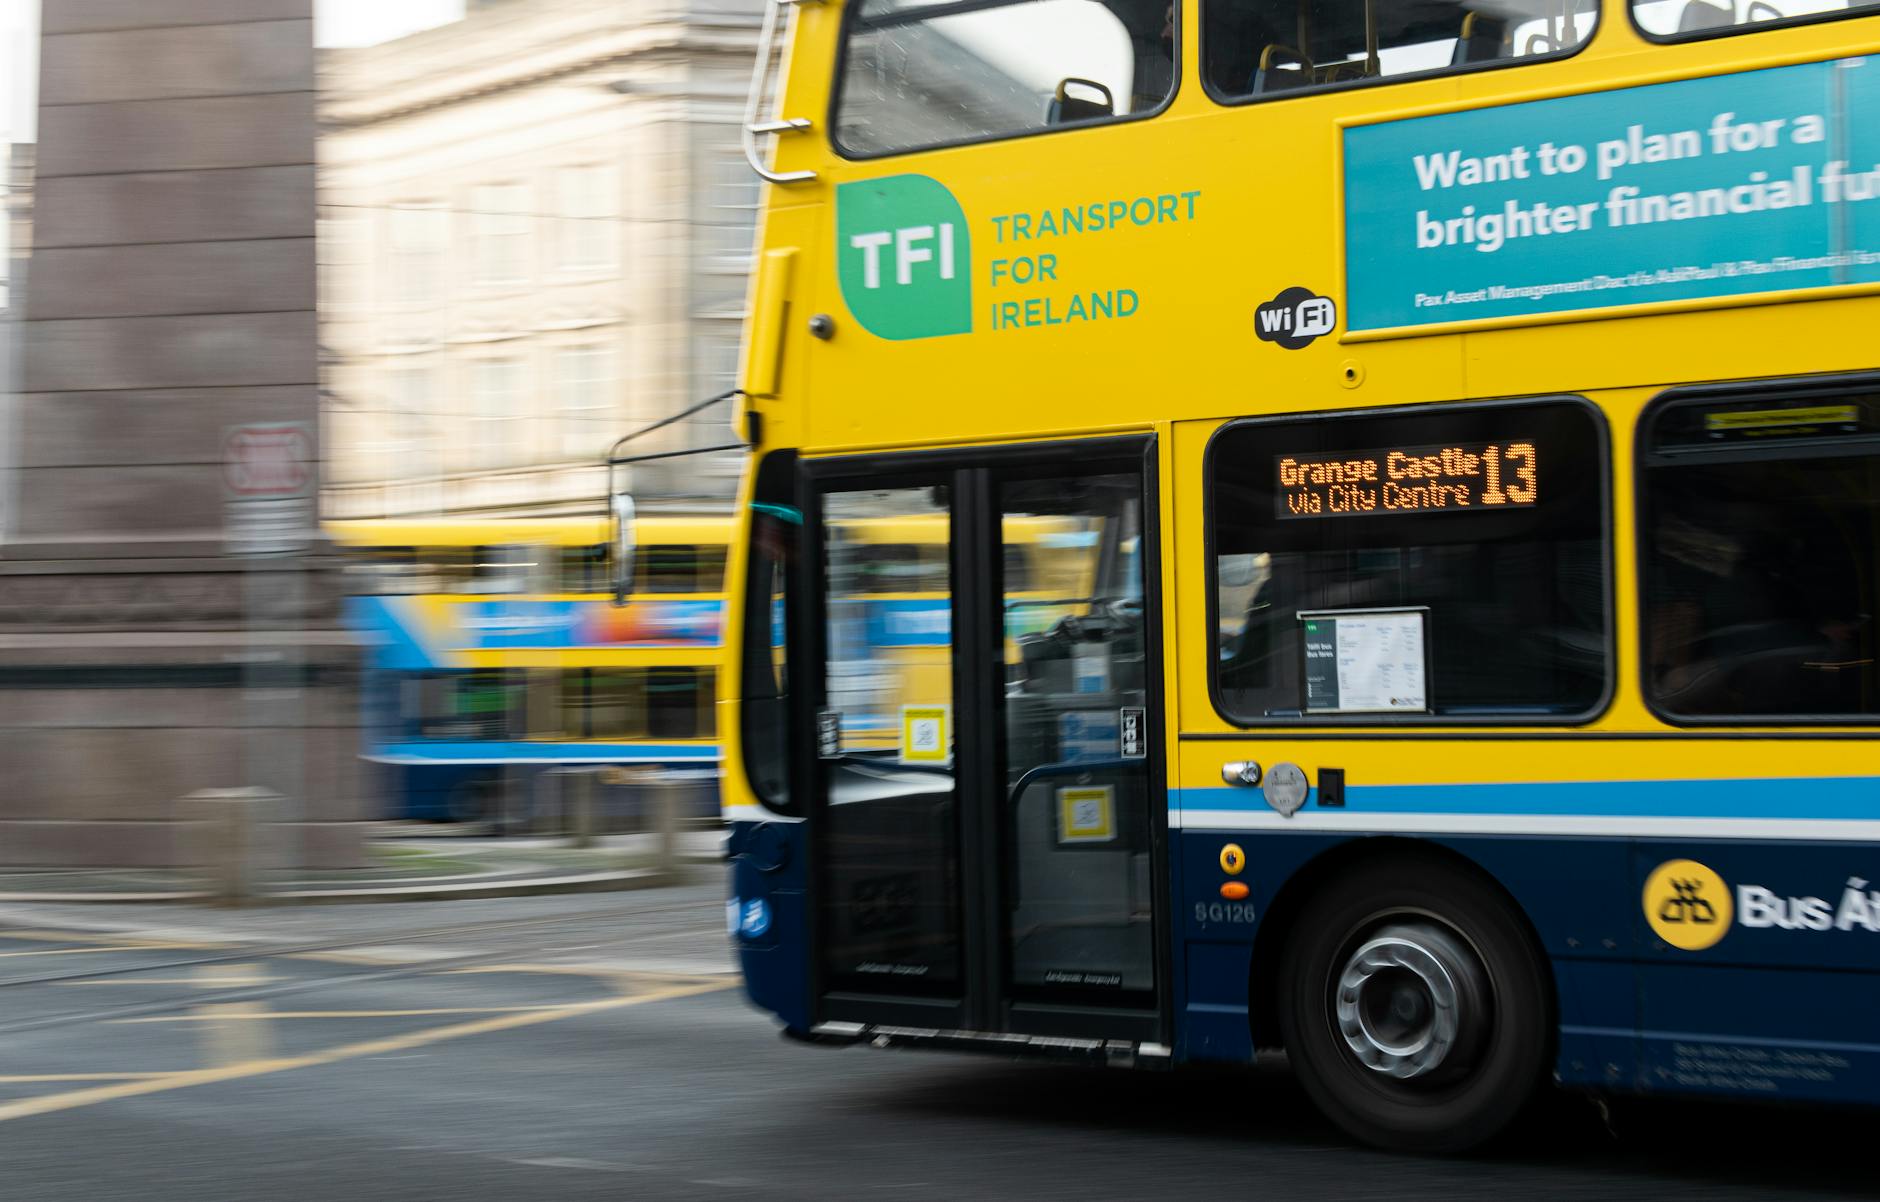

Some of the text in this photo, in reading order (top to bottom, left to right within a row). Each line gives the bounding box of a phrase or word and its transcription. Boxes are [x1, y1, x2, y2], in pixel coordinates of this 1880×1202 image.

[1413, 112, 1825, 191] Want to plan for a
[991, 190, 1201, 243] TRANSPORT
[1416, 200, 1599, 253] brighter
[1604, 165, 1813, 227] financial
[850, 222, 955, 289] TFI
[991, 253, 1058, 287] FOR
[992, 289, 1139, 330] IRELAND
[1444, 288, 1487, 304] Asset
[1488, 277, 1592, 299] Management
[1280, 447, 1480, 485] Grange Castle
[1481, 443, 1537, 505] 13
[1288, 479, 1470, 514] via City Centre
[1194, 901, 1256, 923] SG126
[1736, 883, 1834, 932] Bus
